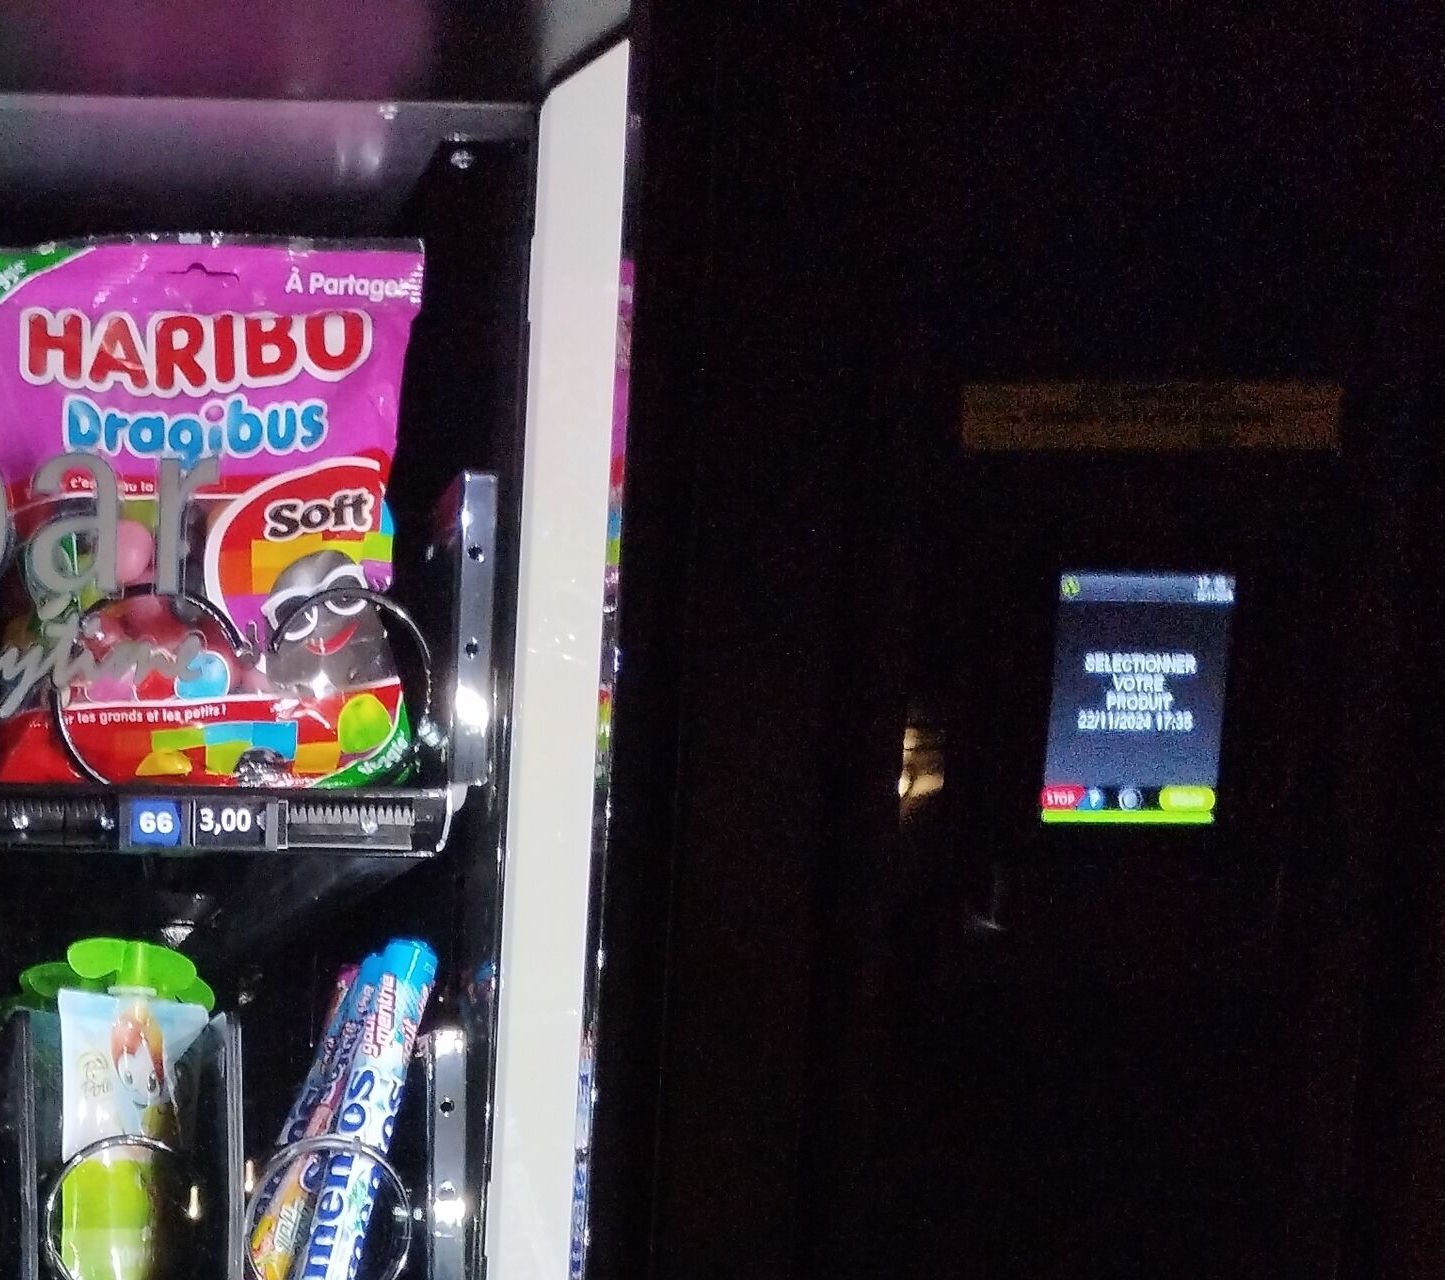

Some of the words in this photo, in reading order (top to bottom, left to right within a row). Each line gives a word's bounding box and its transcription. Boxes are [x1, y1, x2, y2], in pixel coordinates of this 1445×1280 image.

[285, 268, 303, 295] À
[23, 309, 371, 393] HARIBO
[65, 396, 327, 458] Dragibus
[265, 490, 372, 540] Soft
[1083, 651, 1198, 674] SELECTIONNER
[1112, 673, 1165, 693] VOTRE
[1105, 690, 1175, 712] PRODUIT
[139, 810, 173, 834] 66
[199, 808, 251, 836] 3,00
